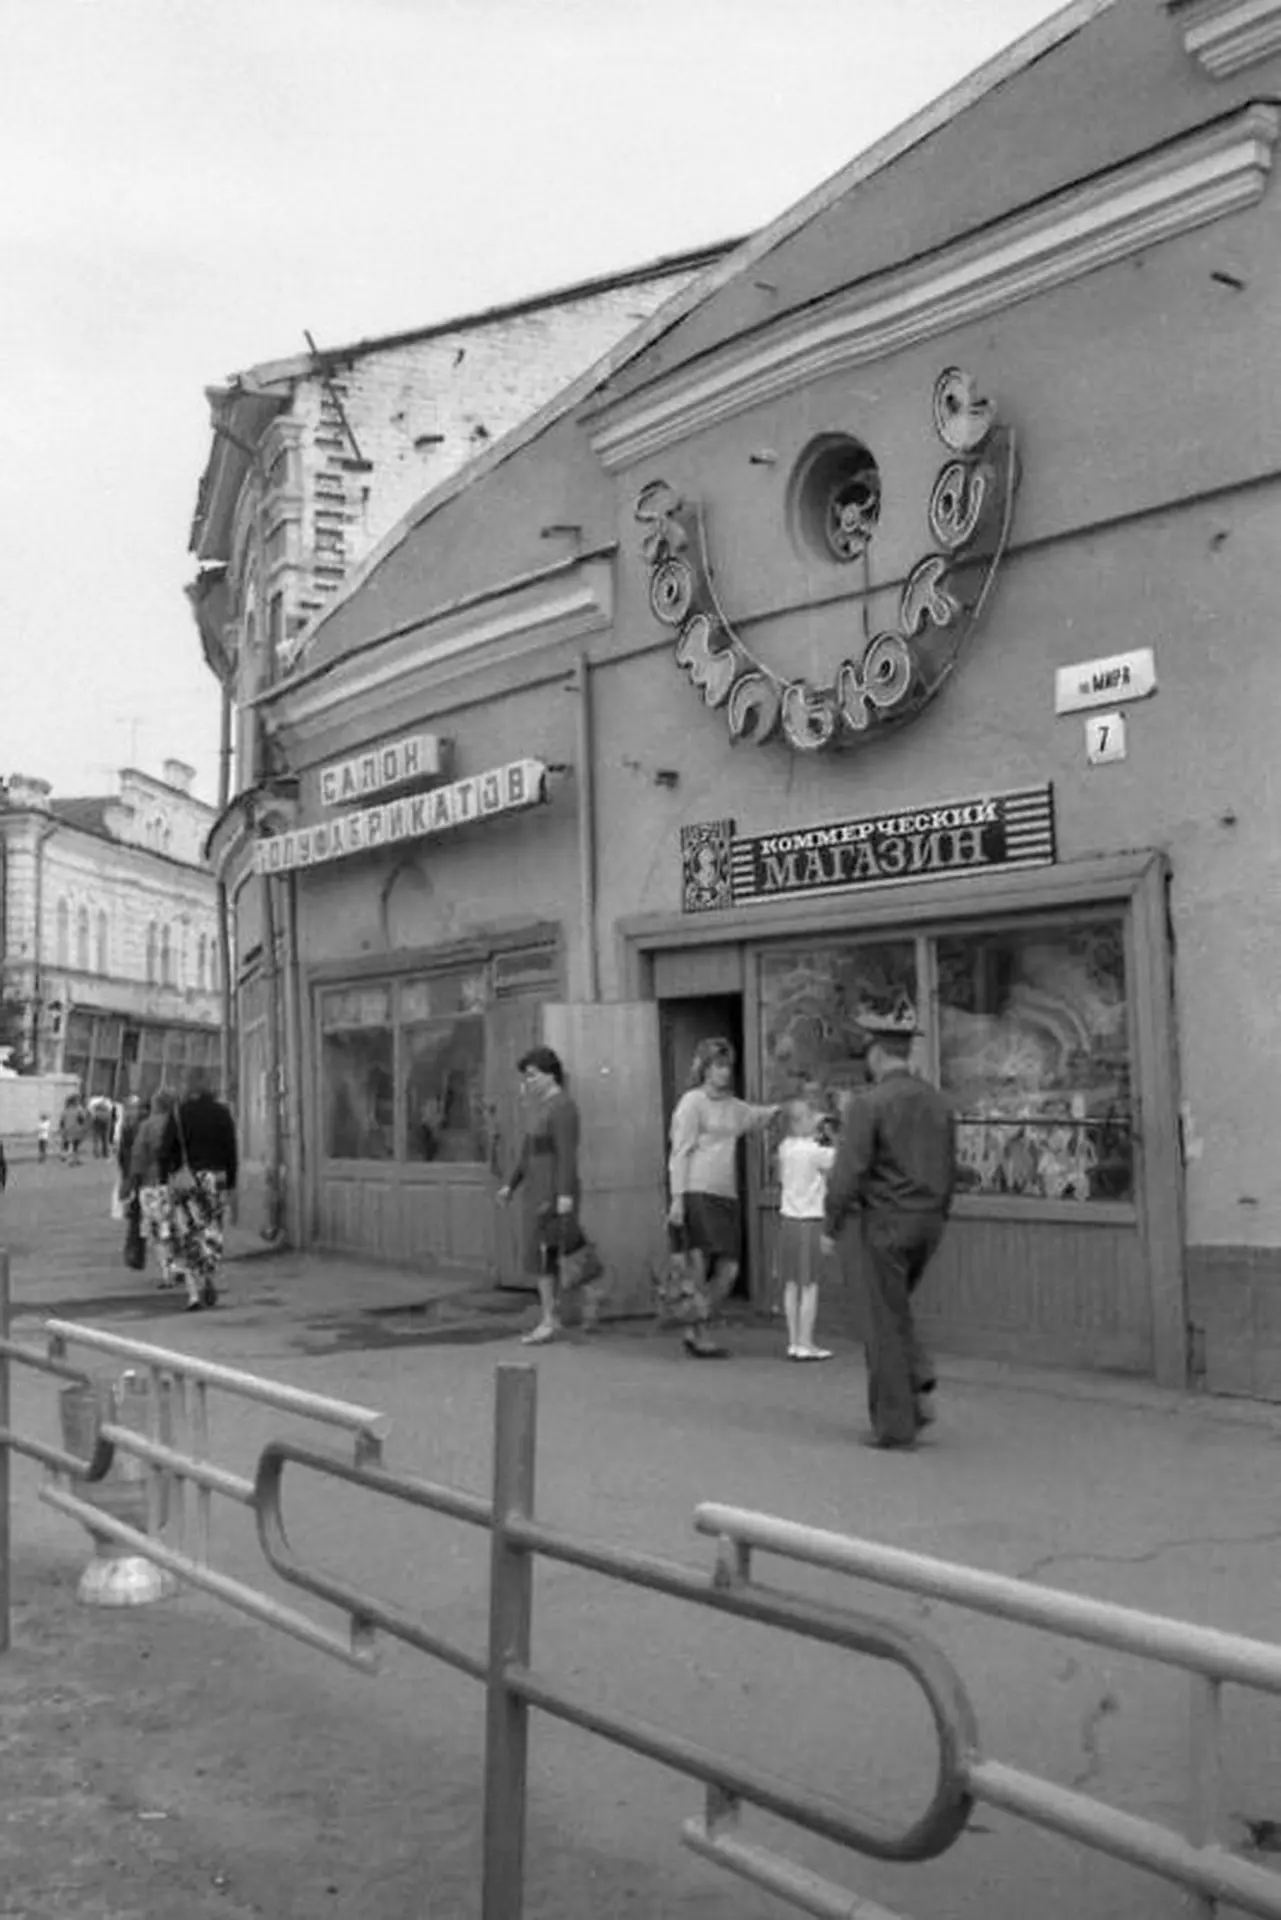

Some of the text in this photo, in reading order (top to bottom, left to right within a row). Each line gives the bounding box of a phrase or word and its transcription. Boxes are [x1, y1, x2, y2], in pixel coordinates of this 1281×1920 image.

[1099, 726, 1110, 753] 7
[322, 741, 419, 801] САЛОН
[760, 798, 997, 855] КОММЕРЧЕСКИЙ
[763, 825, 989, 890] МАГАЗИН
